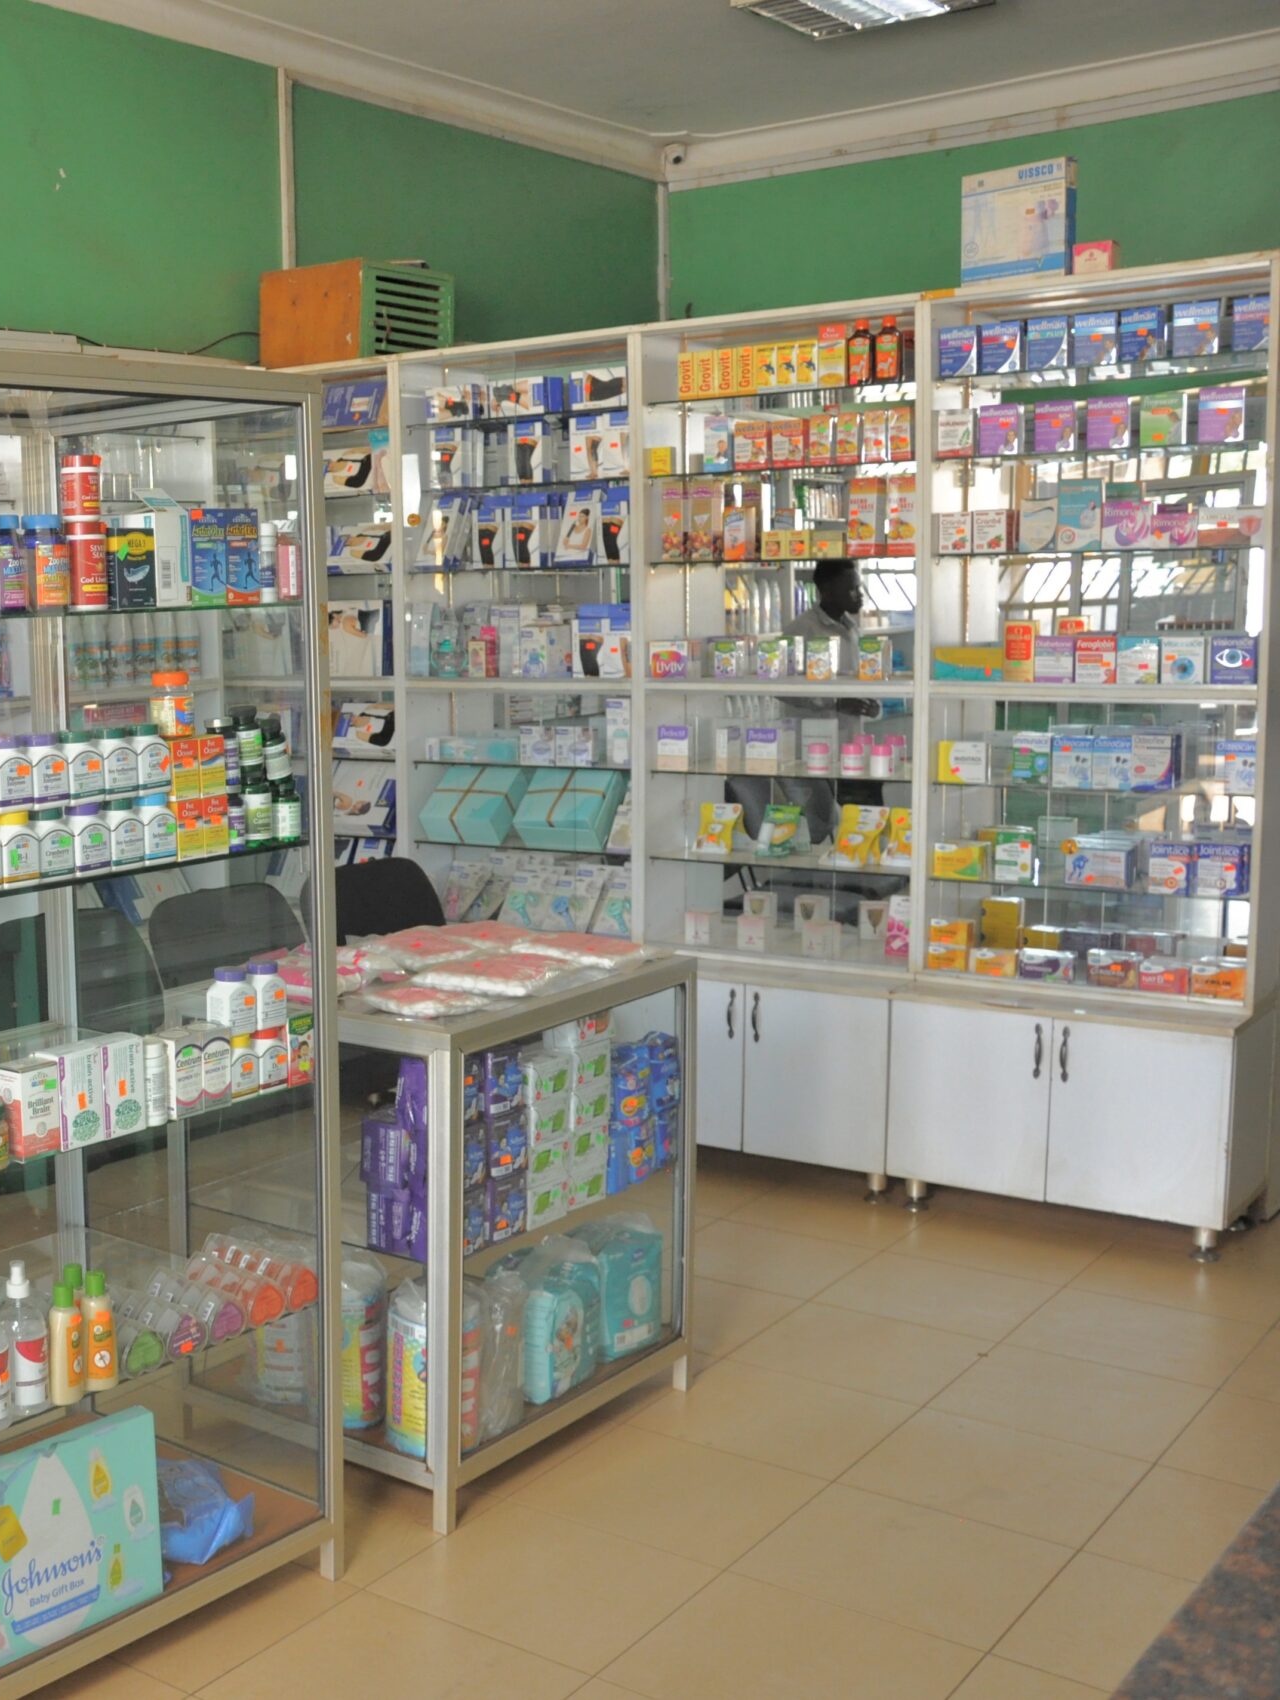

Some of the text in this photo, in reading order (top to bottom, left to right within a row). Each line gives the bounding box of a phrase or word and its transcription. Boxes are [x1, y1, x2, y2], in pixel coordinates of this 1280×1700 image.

[203, 1048, 230, 1060] Centrum
[27, 1096, 54, 1109] Brilliant
[32, 1106, 51, 1116] Brain
[1, 1539, 103, 1617] Johnson's
[29, 1578, 85, 1608] Baby Gift Box
